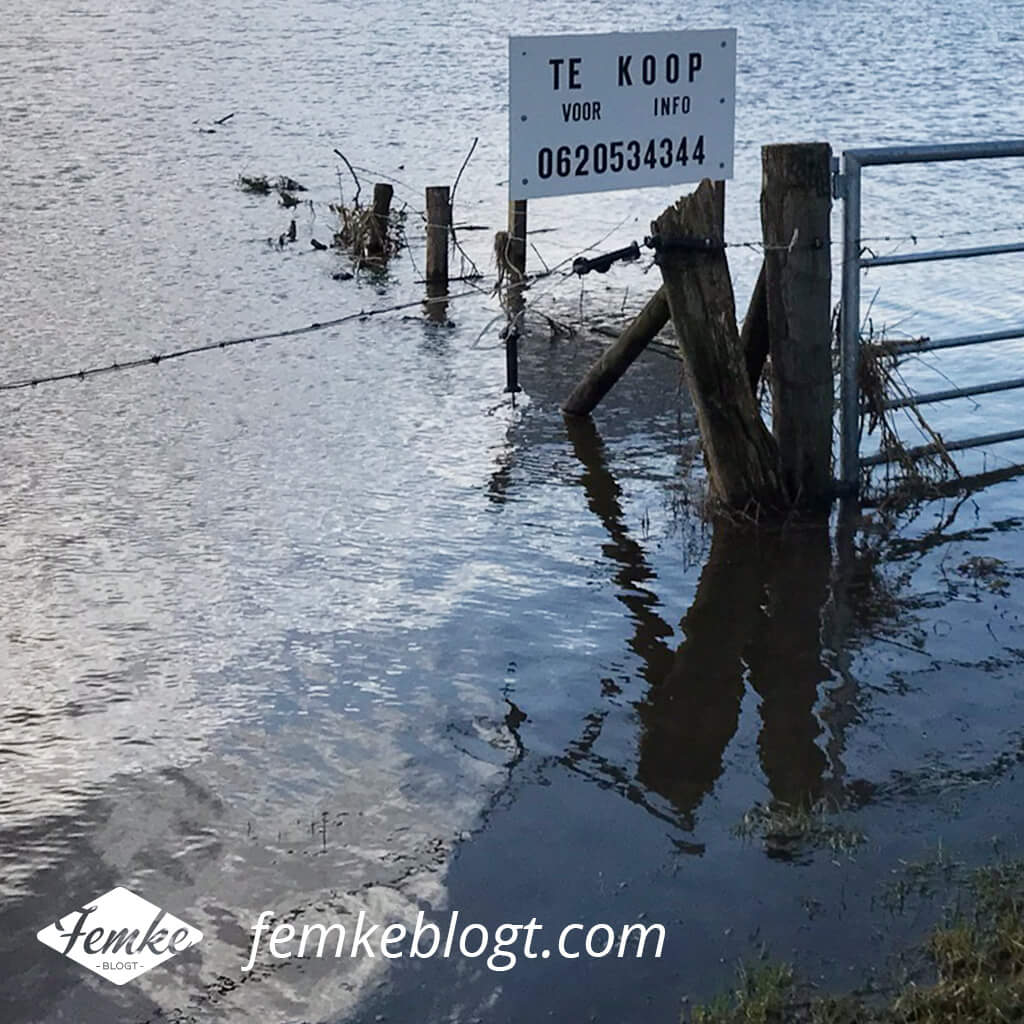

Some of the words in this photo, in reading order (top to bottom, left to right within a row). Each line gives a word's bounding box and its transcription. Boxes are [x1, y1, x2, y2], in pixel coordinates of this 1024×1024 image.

[549, 58, 582, 90] TE
[618, 52, 702, 87] KOOP
[562, 101, 601, 122] VOOR
[654, 95, 691, 117] INFO
[538, 134, 706, 179] 0620534344
